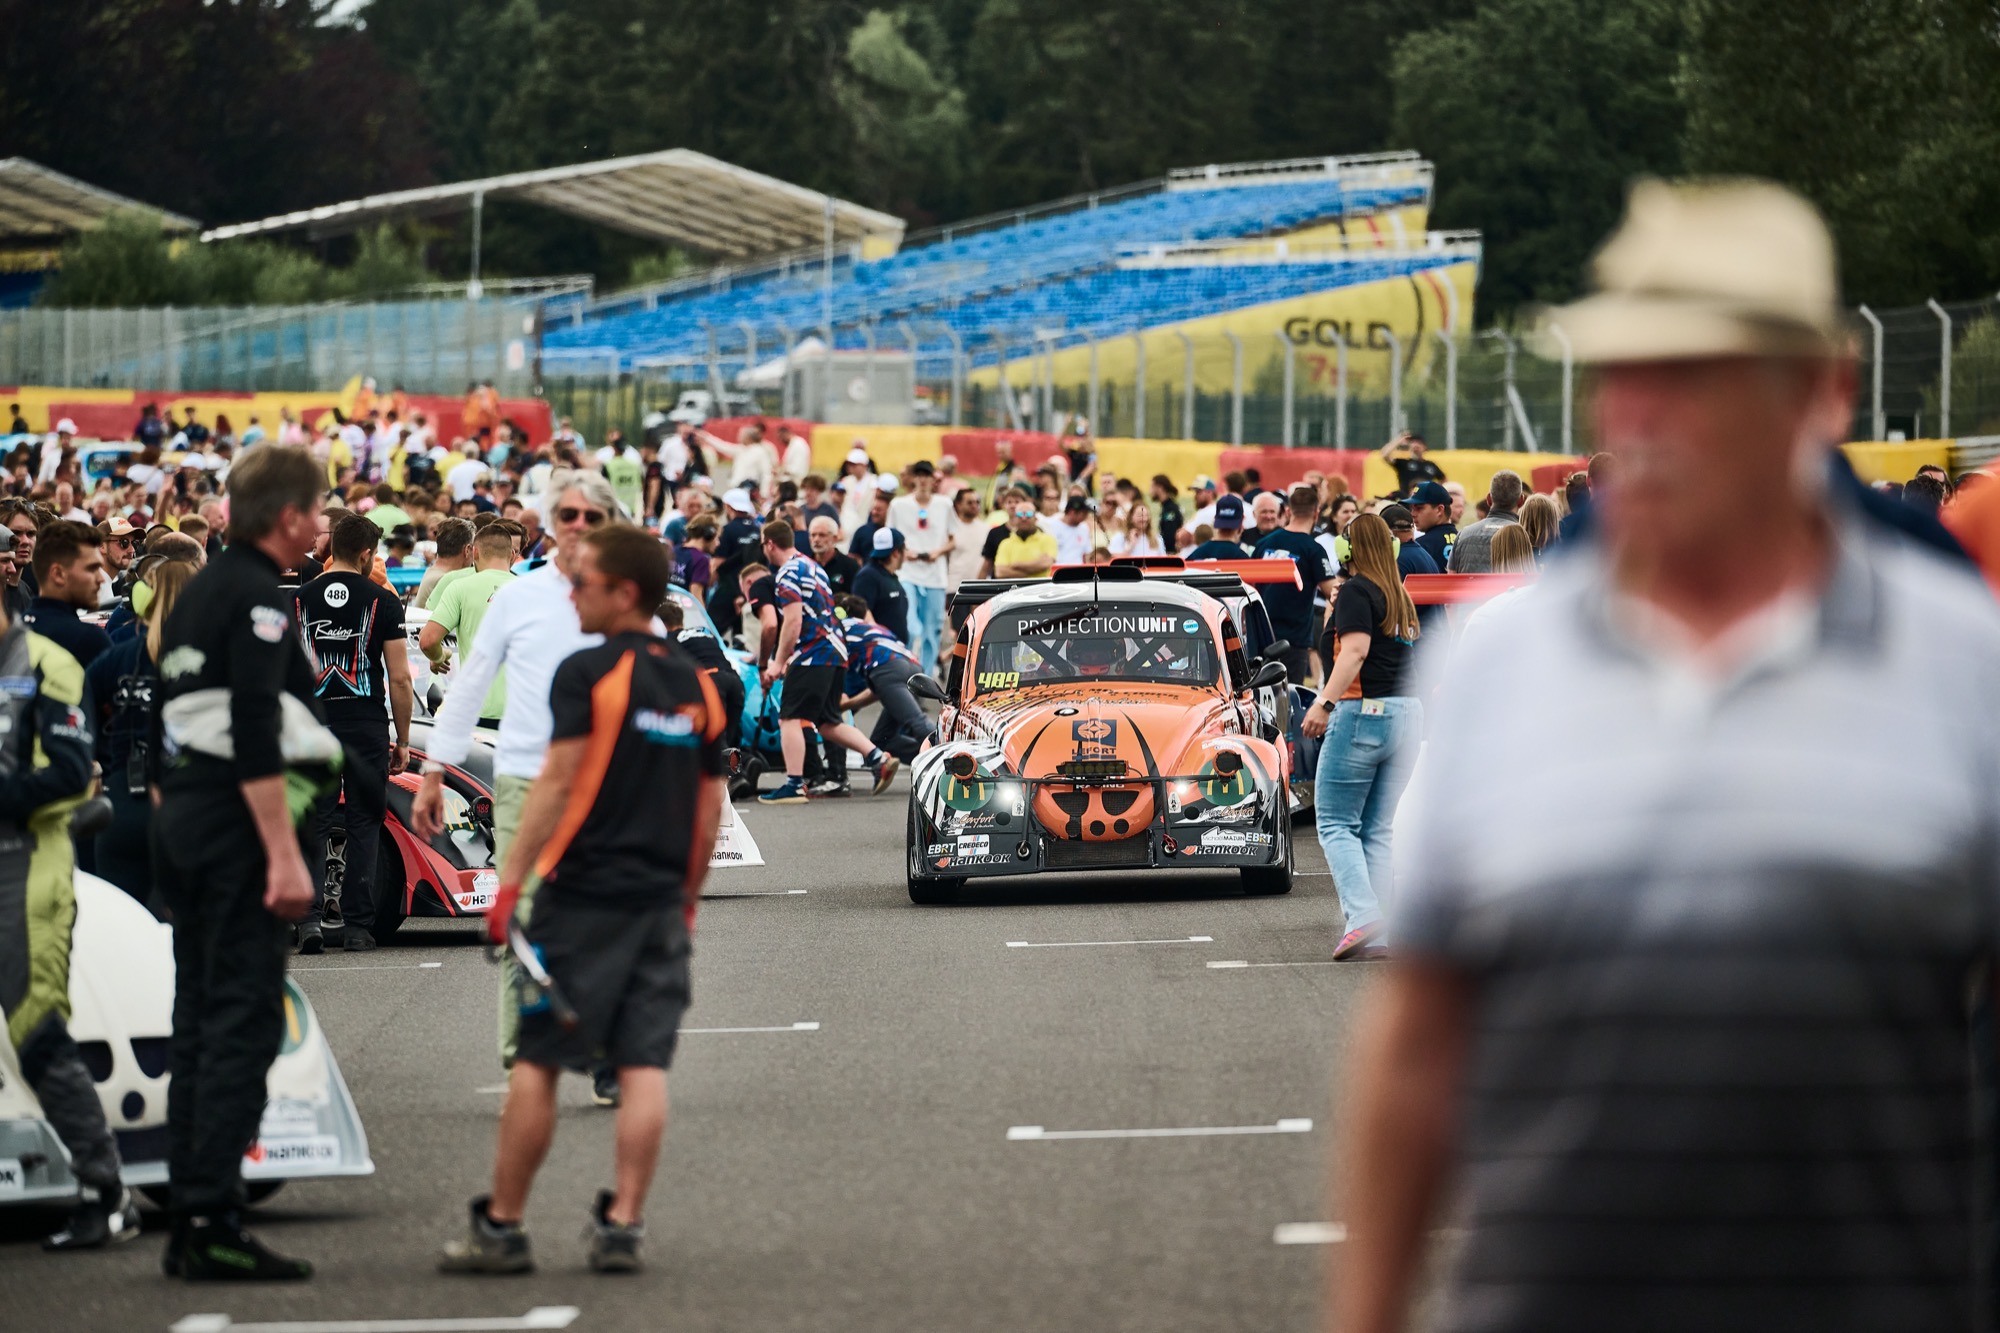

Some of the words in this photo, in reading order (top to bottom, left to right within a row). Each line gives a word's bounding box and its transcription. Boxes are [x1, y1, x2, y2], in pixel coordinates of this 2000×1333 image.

[1284, 317, 1393, 350] GOLD
[327, 590, 347, 600] 488
[306, 620, 365, 640] Racing
[978, 672, 1020, 688] 489
[476, 803, 490, 814] 488
[1246, 832, 1273, 844] EBRT
[928, 843, 956, 854] EBRT
[958, 841, 989, 849] CREDECO
